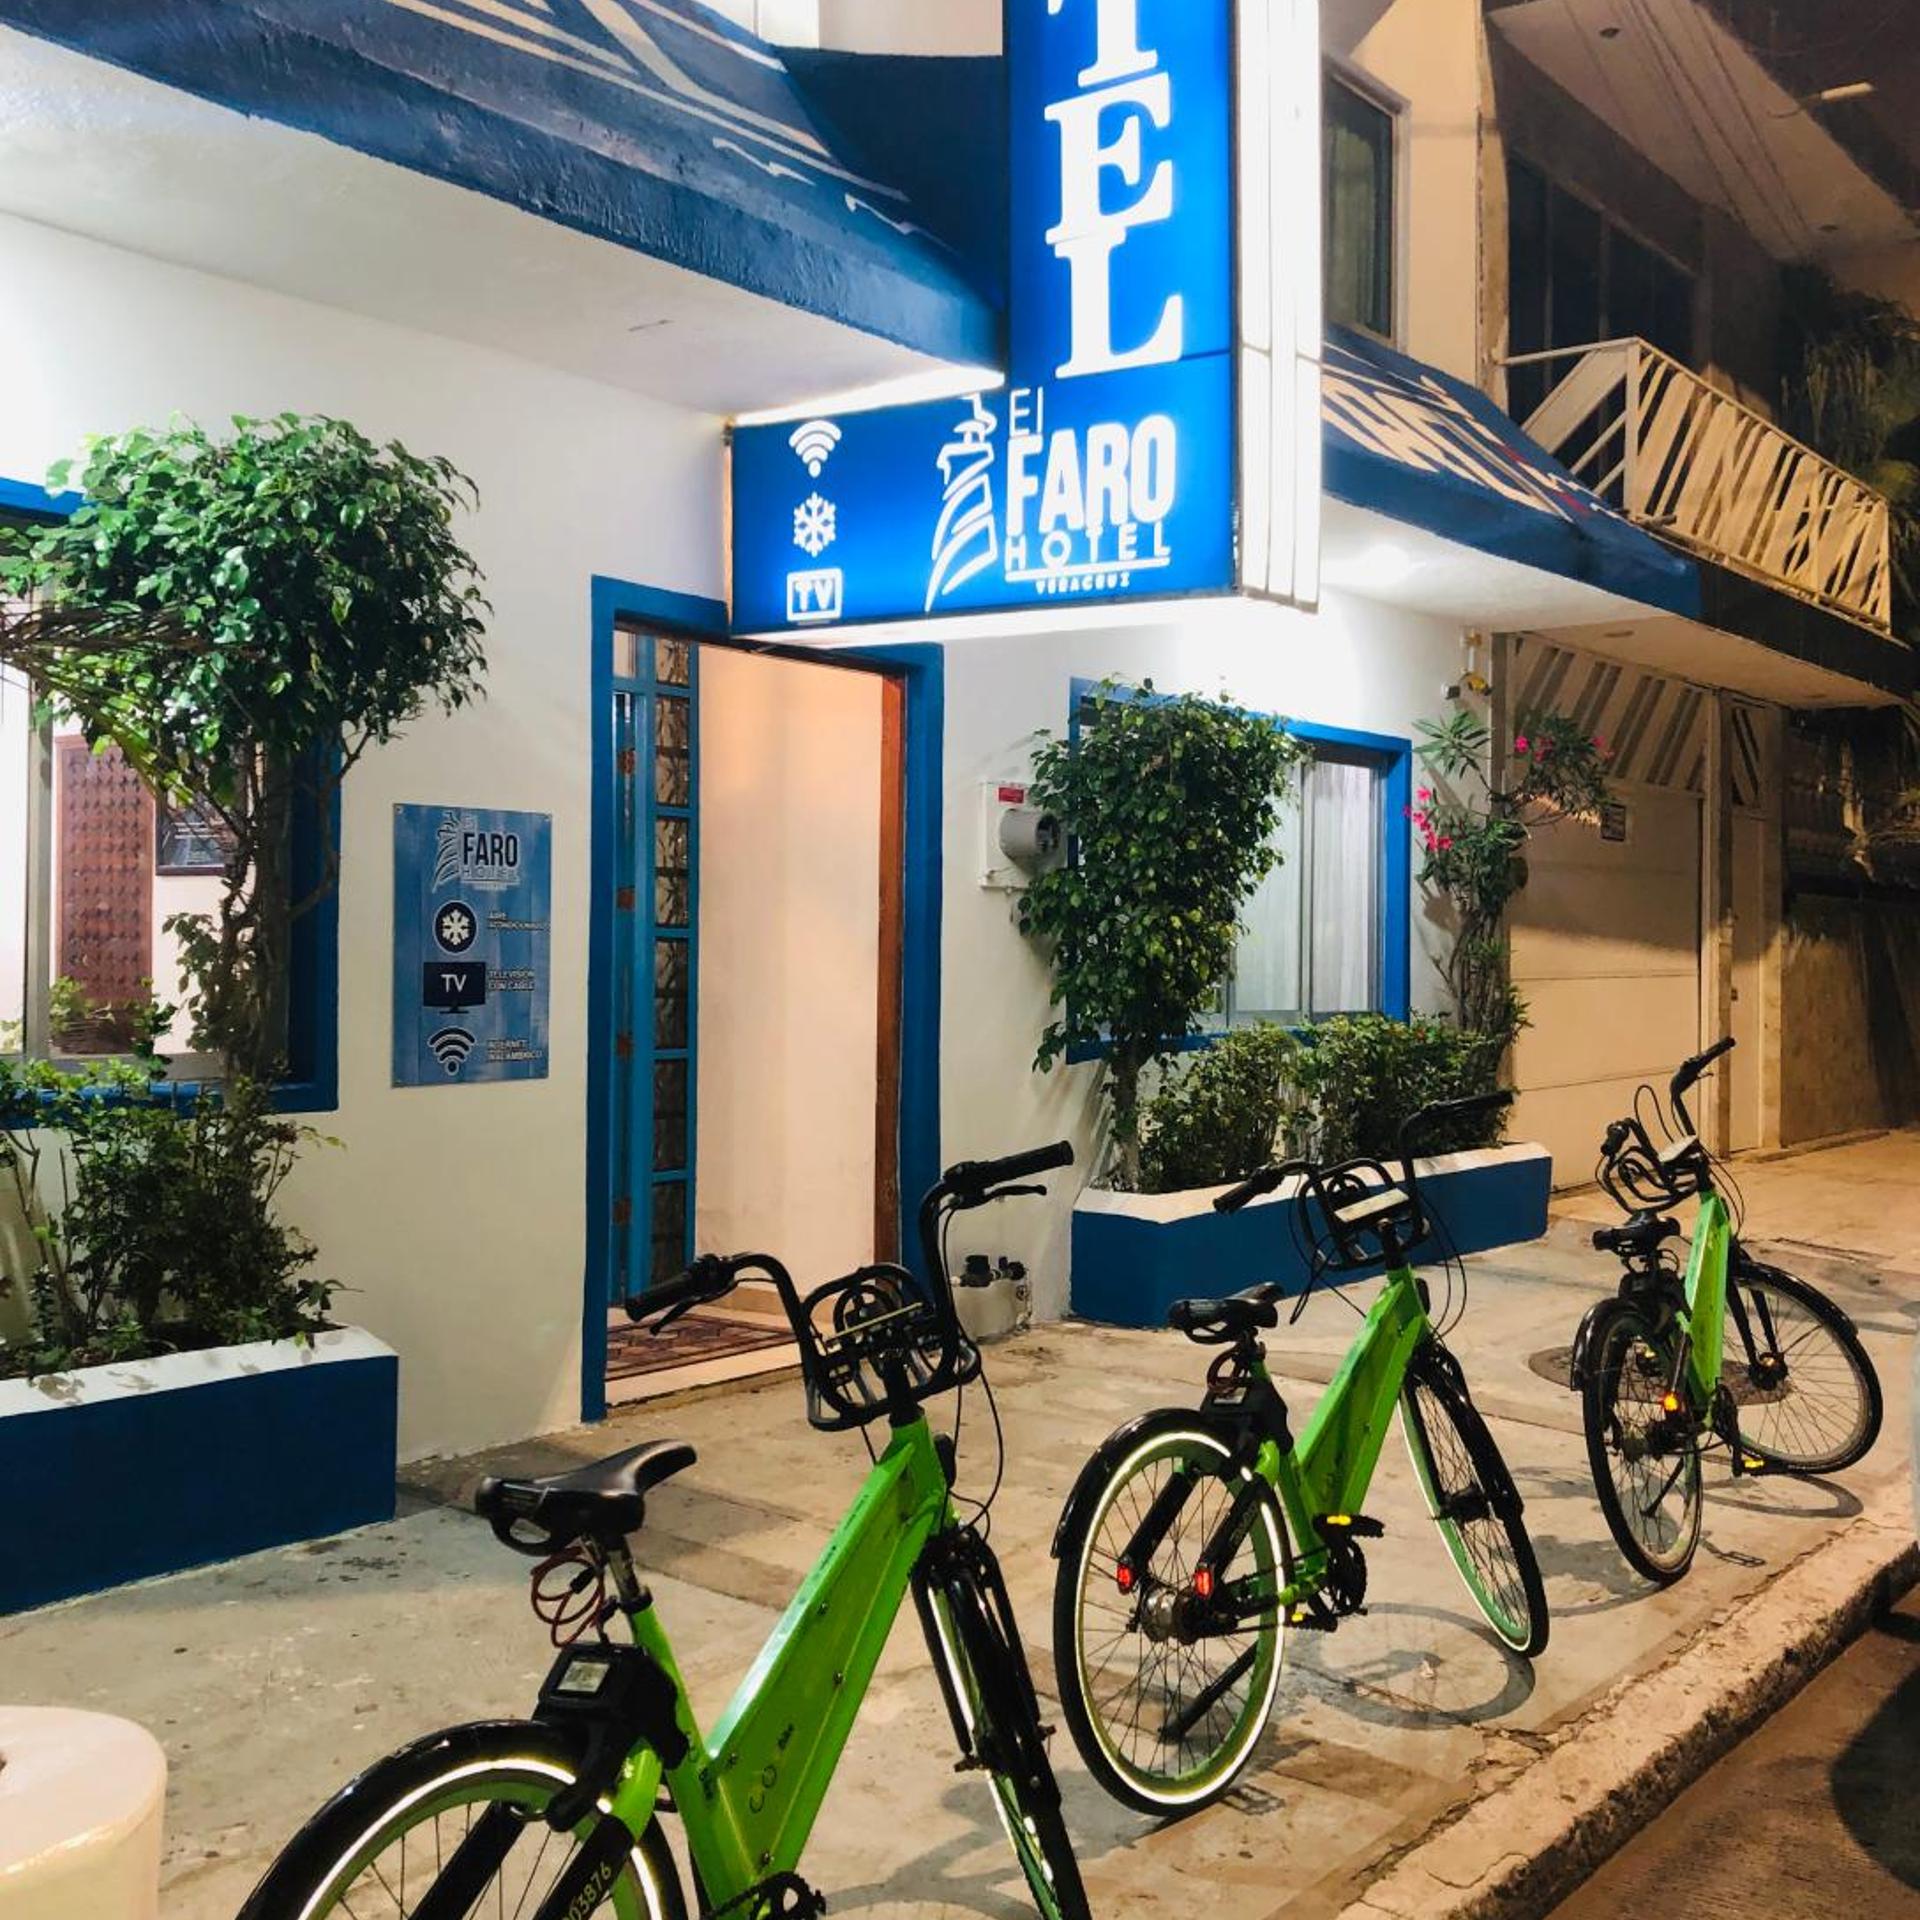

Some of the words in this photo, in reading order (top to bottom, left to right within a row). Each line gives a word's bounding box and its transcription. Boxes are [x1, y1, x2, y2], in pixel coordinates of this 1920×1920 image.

[1006, 414, 1177, 537] FARO
[1005, 521, 1172, 571] HOTEL
[794, 578, 833, 611] TV
[1035, 572, 1131, 595] VERACRUZ
[463, 832, 518, 867] FARO
[440, 974, 467, 993] TV
